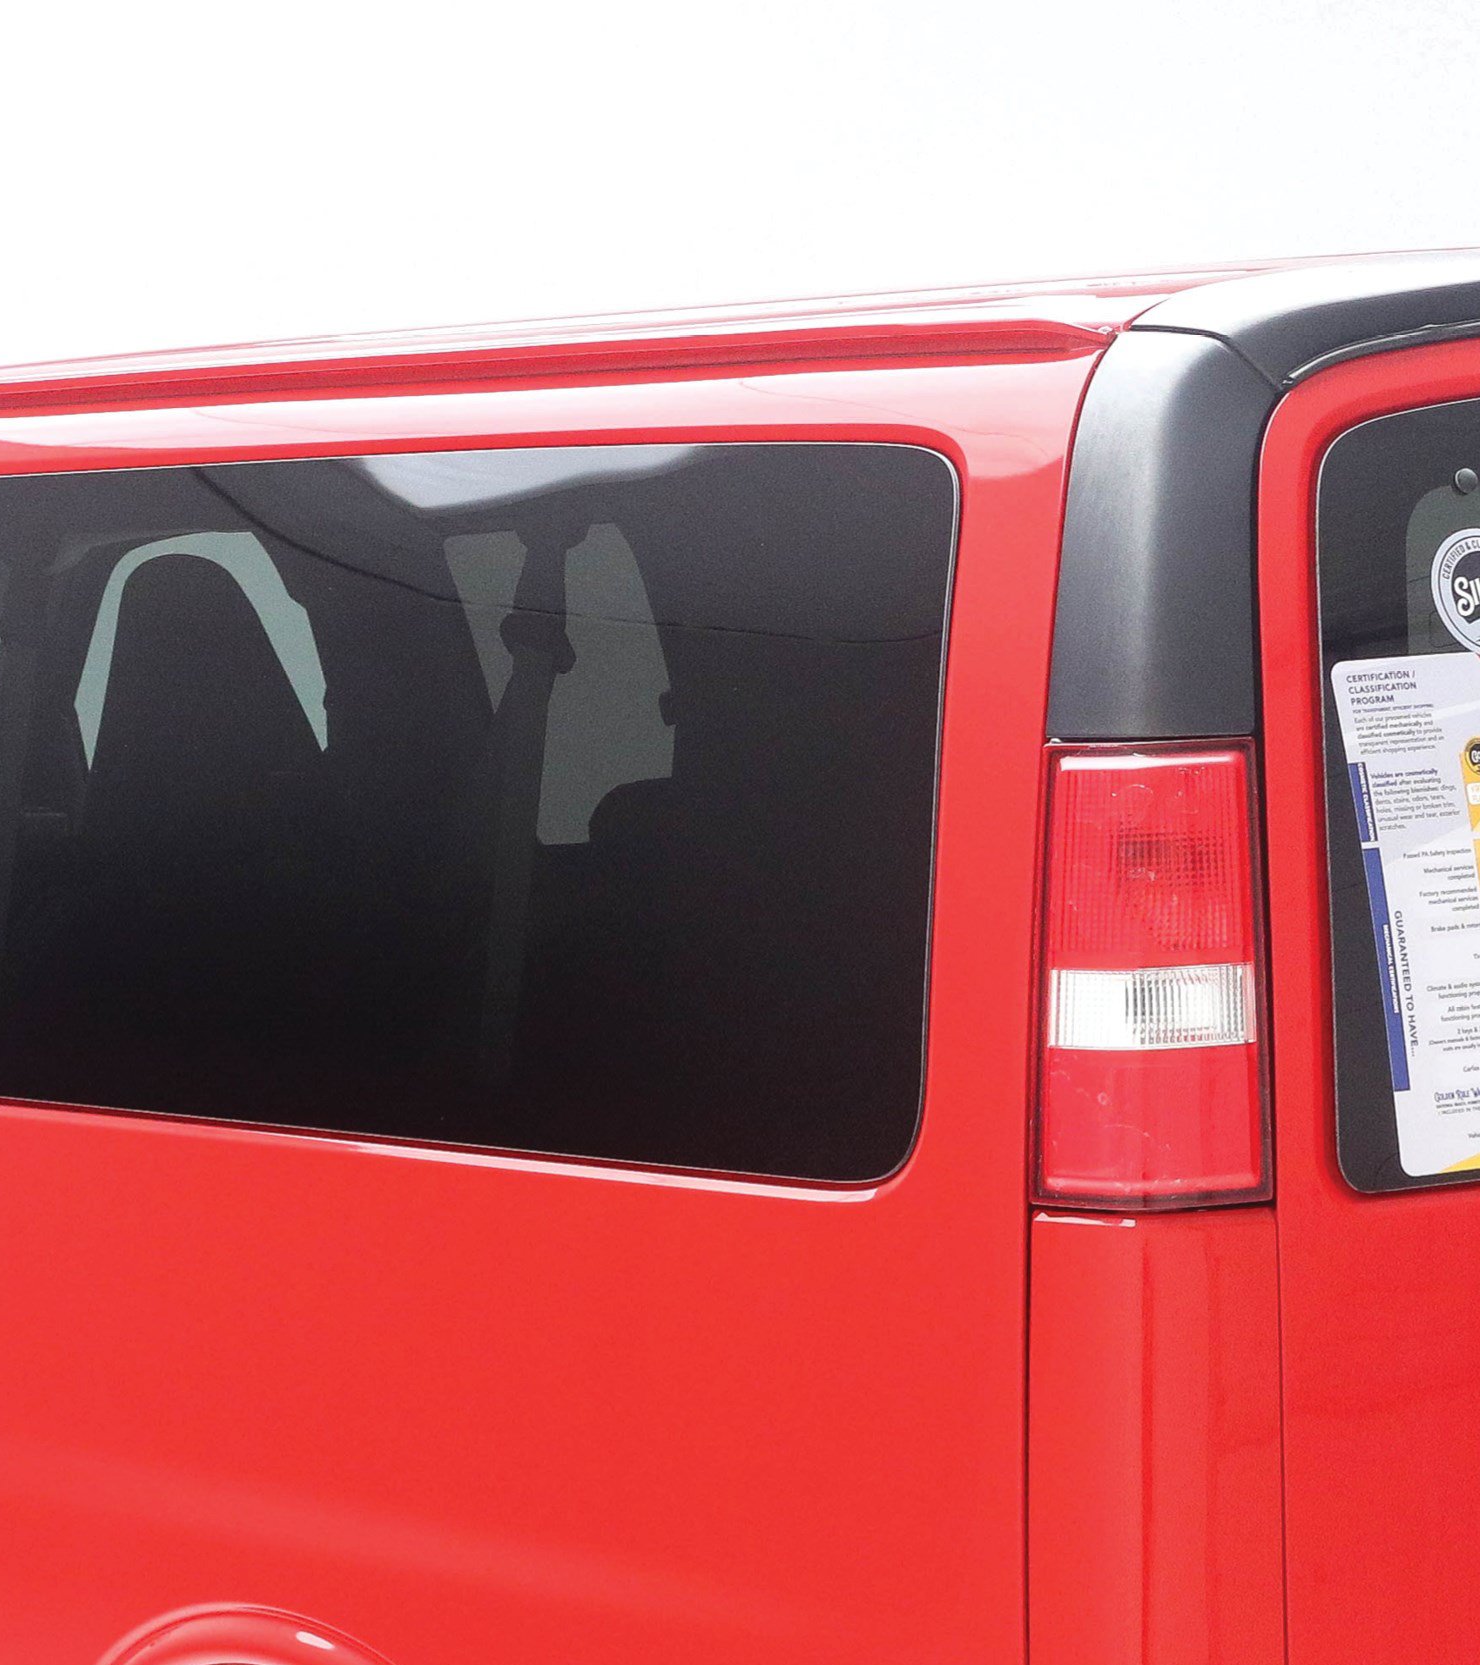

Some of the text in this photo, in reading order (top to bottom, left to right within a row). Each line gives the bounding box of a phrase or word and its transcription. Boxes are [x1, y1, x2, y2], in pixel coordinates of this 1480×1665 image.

[1442, 545, 1465, 579] CERTIFIED
[1466, 542, 1471, 550] &
[1346, 671, 1410, 683] CERTIFICATION
[1348, 682, 1417, 694] CLASSIFICATION
[1351, 695, 1394, 705] PROGRAM
[1394, 911, 1412, 991] GUARANTEED
[1405, 995, 1414, 1011] TO
